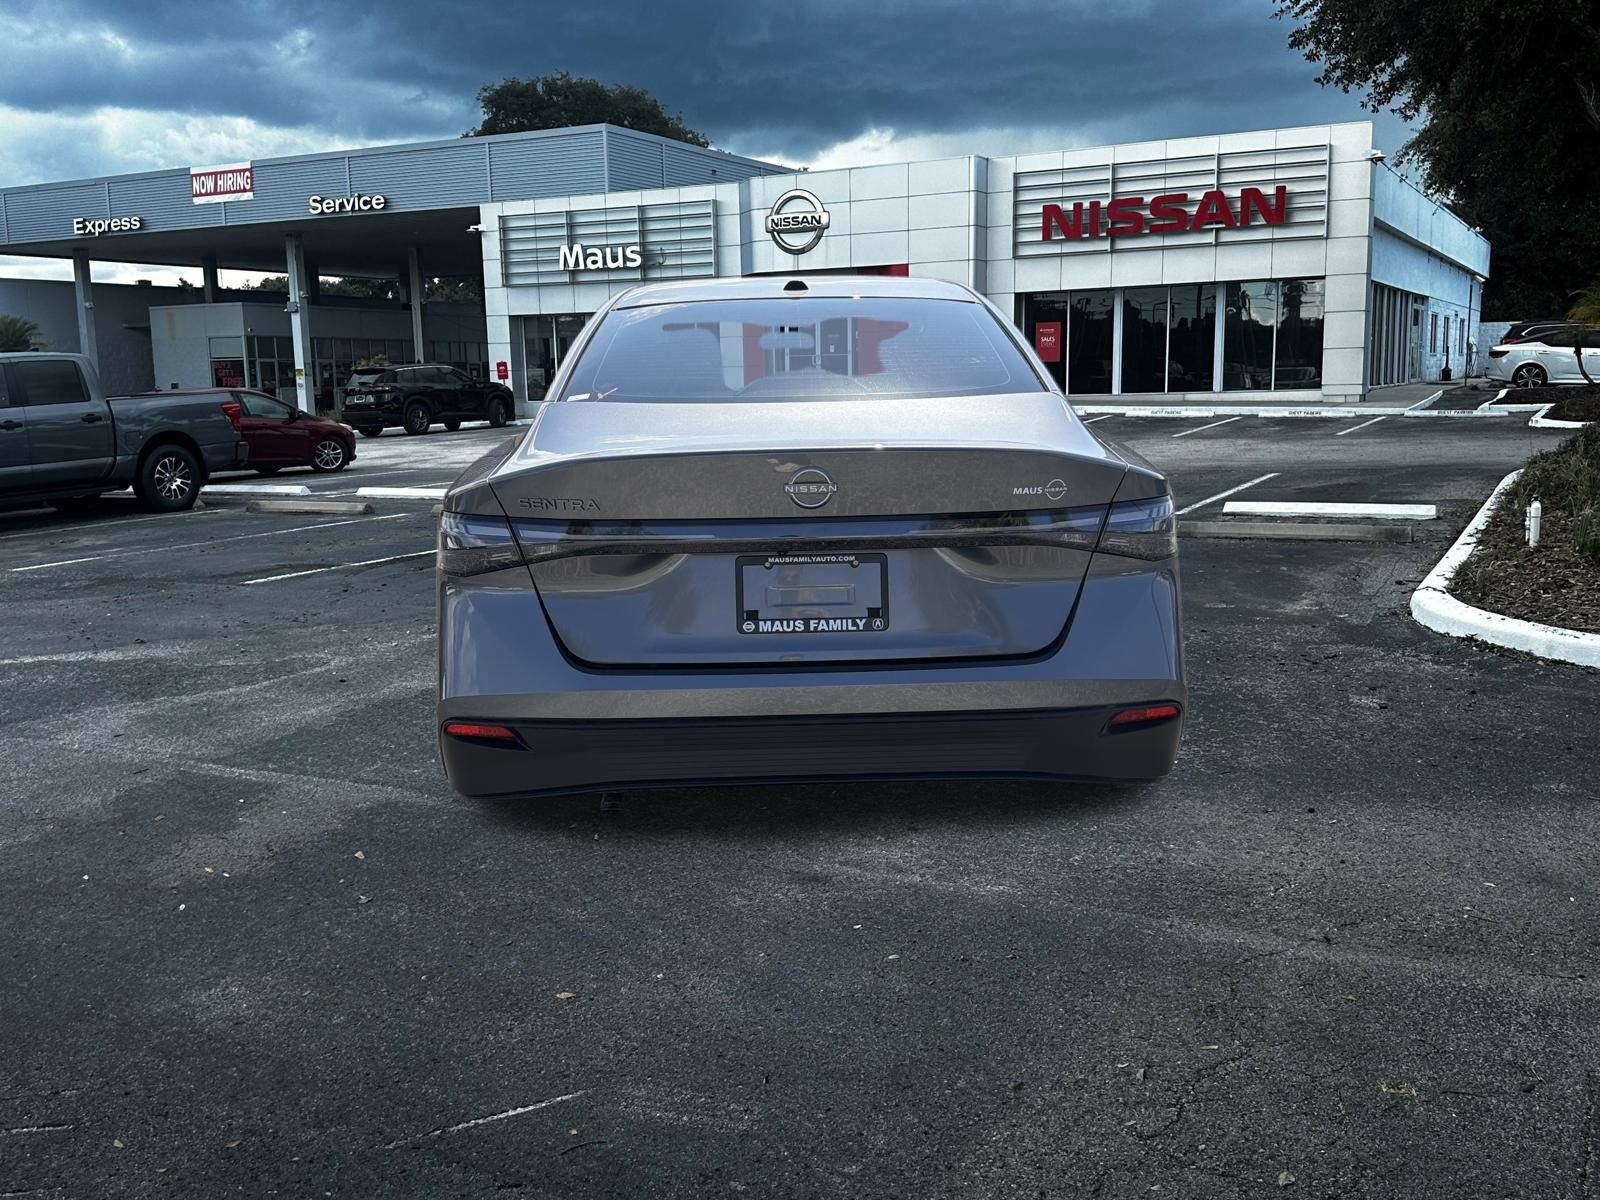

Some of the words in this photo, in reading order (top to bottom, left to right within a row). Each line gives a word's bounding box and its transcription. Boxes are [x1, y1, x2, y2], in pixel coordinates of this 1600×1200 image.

[192, 174, 215, 195] NOW
[217, 171, 251, 192] HIRING
[308, 192, 385, 215] Service
[1041, 185, 1287, 241] NISSAN
[73, 216, 141, 237] Express
[770, 214, 822, 228] NISSAN
[559, 243, 642, 271] Maus
[785, 484, 837, 493] NISSAN
[1012, 486, 1043, 495] MAUS
[519, 497, 601, 511] SENTRA
[767, 555, 856, 563] MAUSFAMILYAUTO.COM
[759, 620, 805, 632] MAUS
[809, 618, 867, 631] FAMILY
